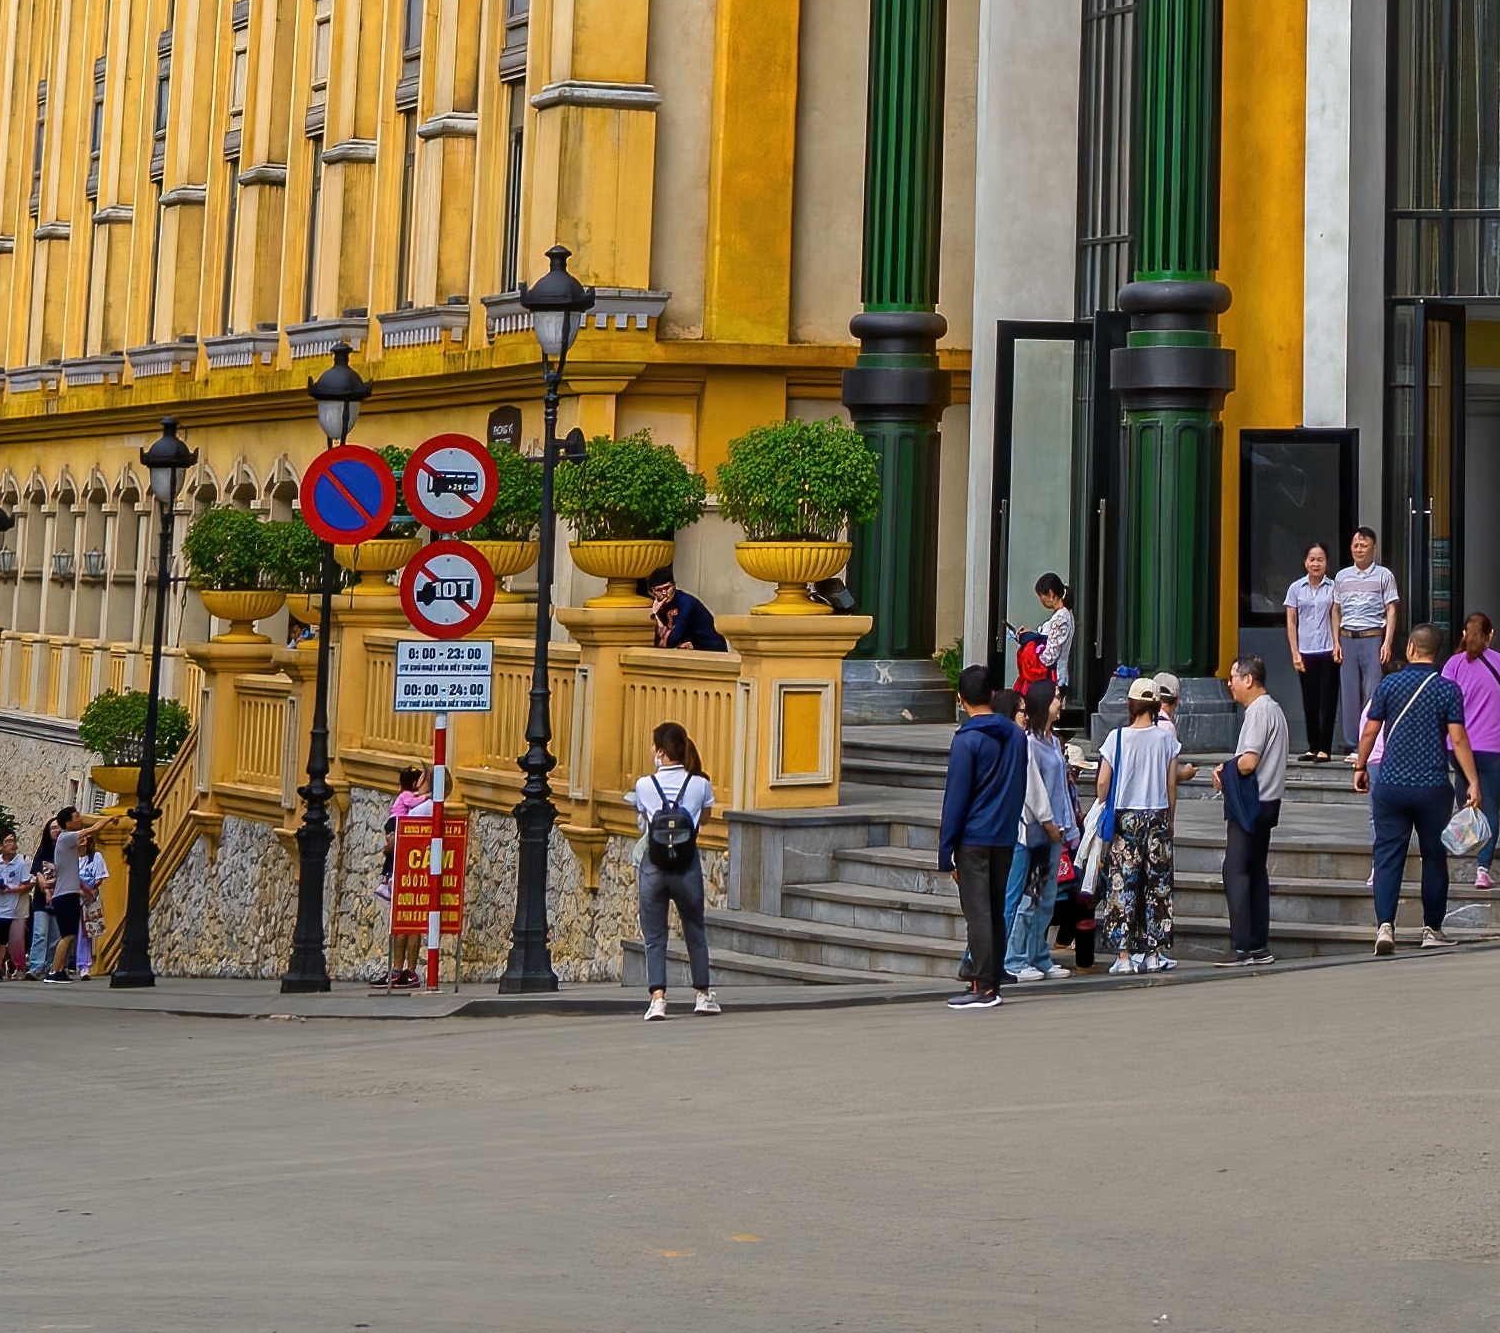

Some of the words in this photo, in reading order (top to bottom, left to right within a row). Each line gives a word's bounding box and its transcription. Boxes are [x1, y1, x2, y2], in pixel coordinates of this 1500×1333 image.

[432, 581, 471, 598] 10T
[447, 647, 465, 660] 23:
[467, 647, 482, 660] 00
[404, 683, 421, 696] 00:
[424, 683, 438, 696] 00
[449, 683, 467, 696] 24:
[469, 683, 484, 696] 00
